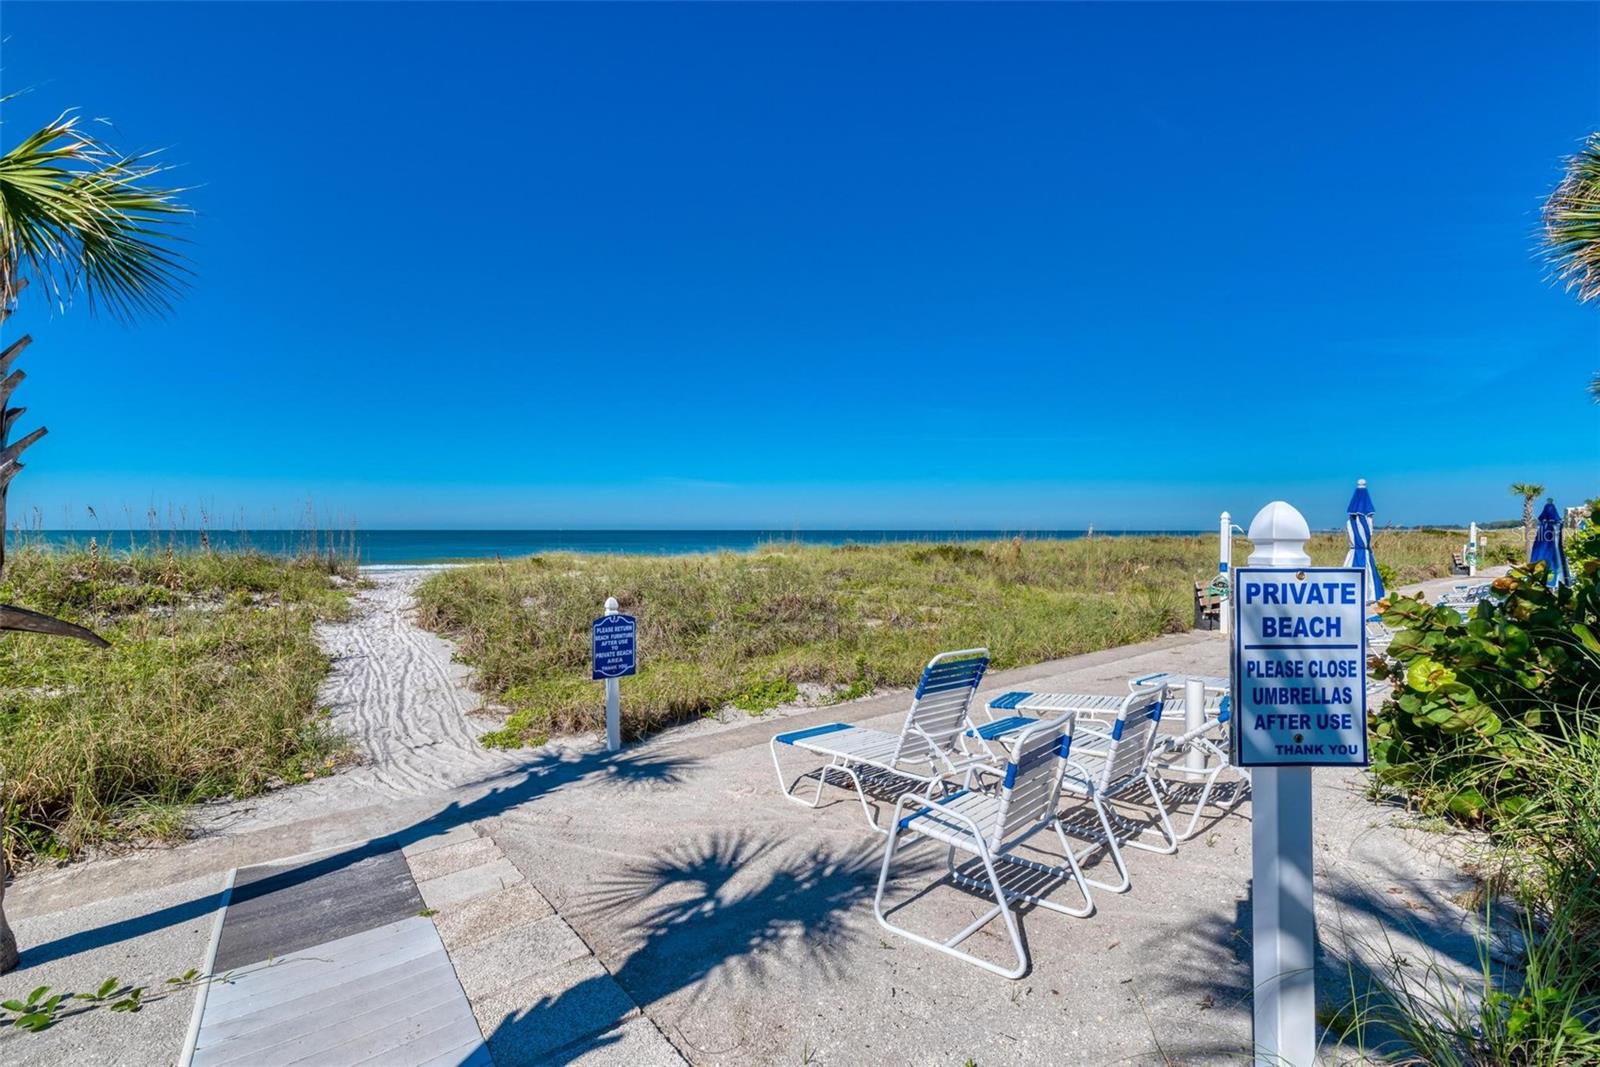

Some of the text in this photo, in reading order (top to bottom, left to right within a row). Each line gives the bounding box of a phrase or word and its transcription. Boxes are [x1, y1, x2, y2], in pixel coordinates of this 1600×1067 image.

[1246, 583, 1356, 605] PRIVATE
[1262, 616, 1342, 638] BEACH
[1247, 660, 1357, 678] PLEASE CLOSE
[1252, 686, 1352, 705] UMBRELLAS
[1254, 714, 1352, 730] AFTER USE
[1275, 744, 1358, 756] THANK YOU
